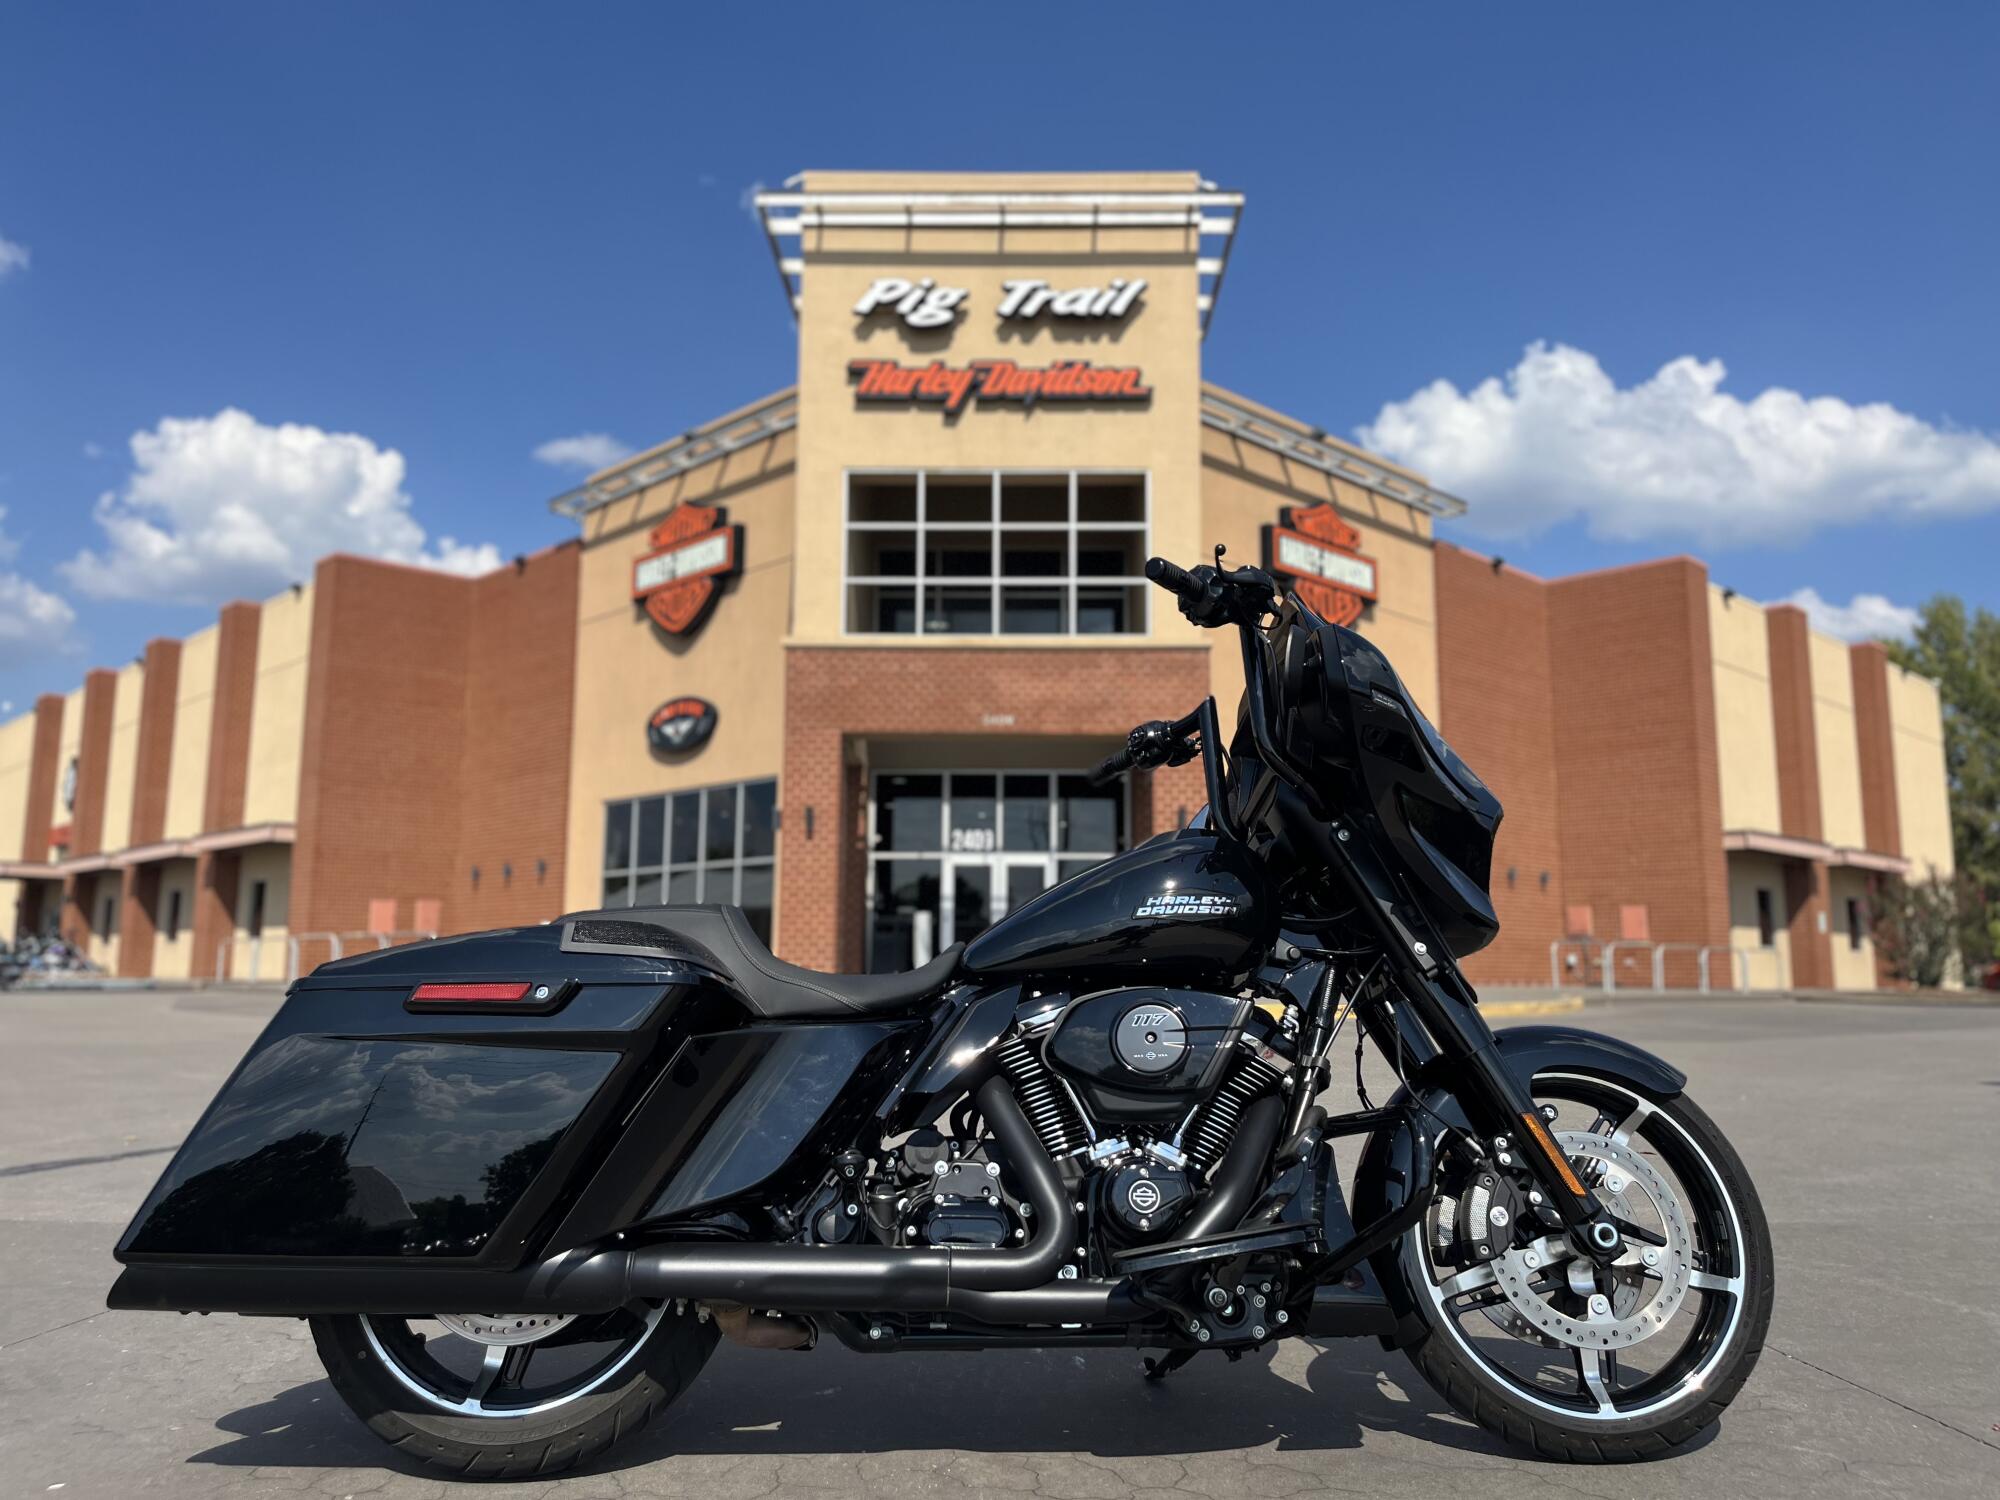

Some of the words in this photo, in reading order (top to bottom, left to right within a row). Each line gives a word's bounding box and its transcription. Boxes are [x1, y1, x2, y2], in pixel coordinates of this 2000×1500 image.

[853, 276, 970, 328] Pig
[996, 278, 1149, 318] Trail
[1146, 895, 1232, 906] HARLEY-
[1135, 905, 1237, 917] DAVIDSON
[1131, 1013, 1170, 1027] 117
